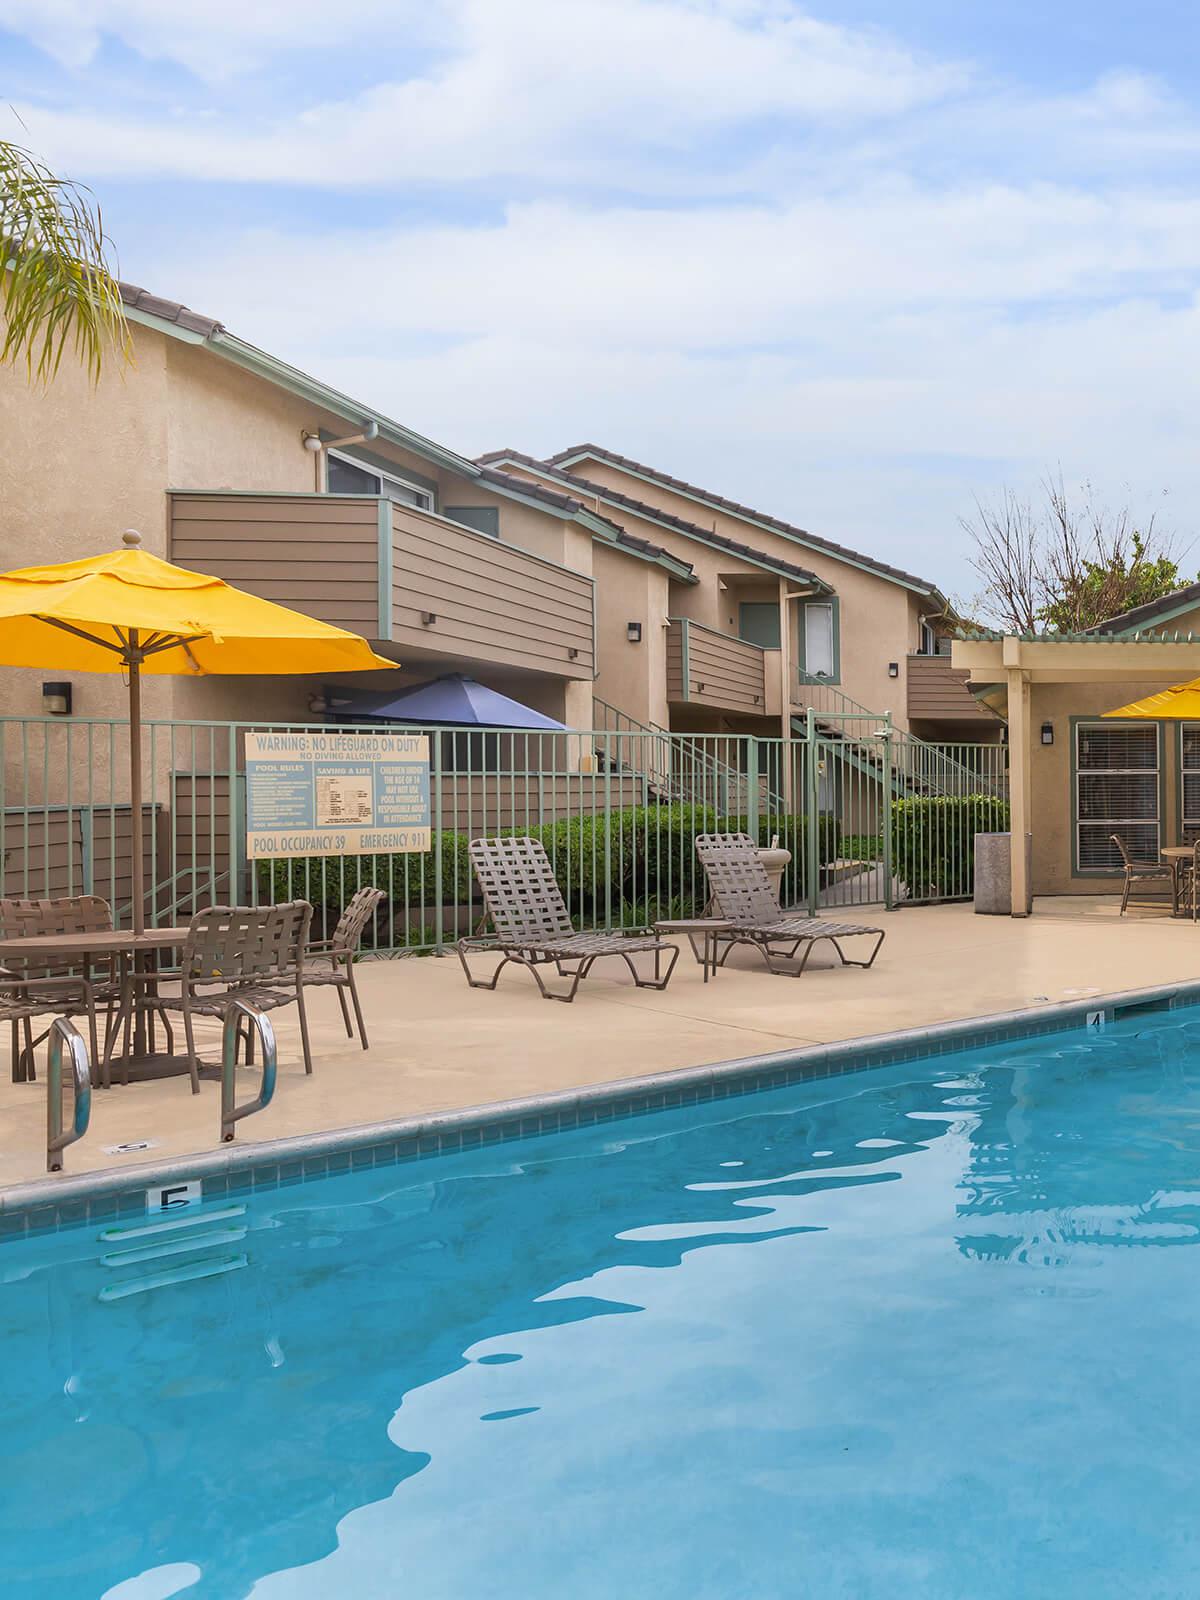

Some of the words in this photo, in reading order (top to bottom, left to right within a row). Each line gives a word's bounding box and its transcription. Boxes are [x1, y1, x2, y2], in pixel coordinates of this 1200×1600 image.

[256, 736, 310, 751] WARNING:
[312, 736, 326, 751] NO
[329, 737, 378, 752] LIFEGUARD
[381, 738, 394, 752] ON
[397, 738, 420, 753] DUTY
[300, 752, 312, 760] NO
[314, 752, 344, 760] DIVING
[346, 752, 382, 760] ALLOWED
[255, 764, 279, 772] POOL
[280, 764, 305, 772] RULES
[318, 767, 346, 775] SAVING
[348, 767, 354, 775] A
[355, 767, 371, 775] LIFE
[254, 837, 278, 852] POOL
[280, 835, 333, 851] OCCUPANCY
[335, 835, 346, 849] 39
[360, 832, 408, 848] EMERGENCY
[411, 833, 425, 846] 911
[160, 1186, 191, 1211] 5
